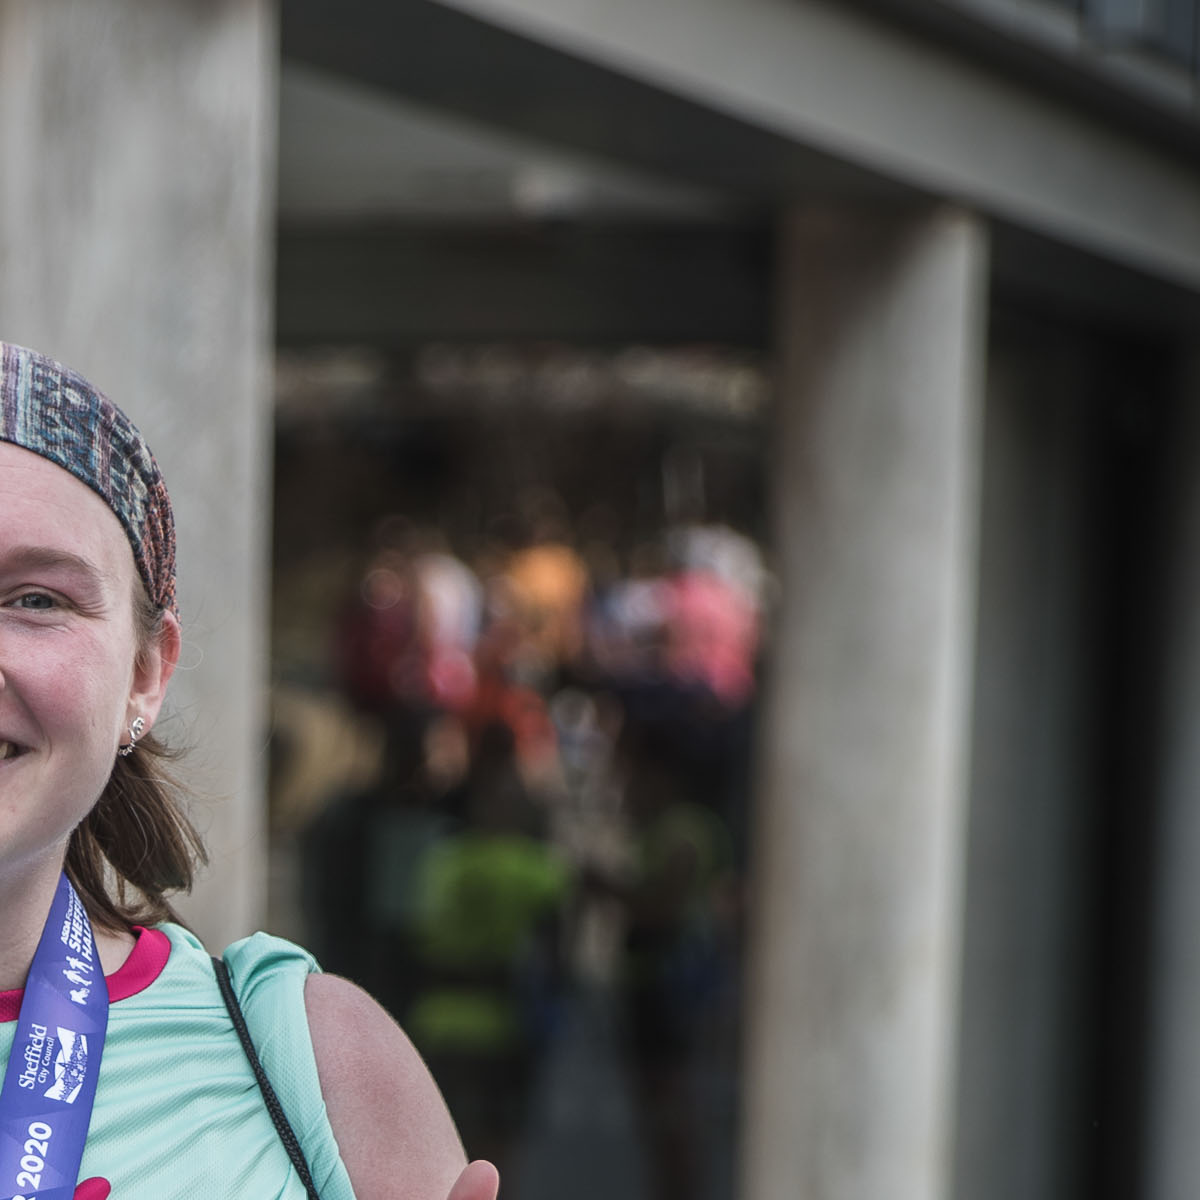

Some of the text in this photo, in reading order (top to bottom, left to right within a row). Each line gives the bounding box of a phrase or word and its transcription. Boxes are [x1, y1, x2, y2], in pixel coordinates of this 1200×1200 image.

[61, 920, 72, 945] ASDA
[81, 918, 93, 962] HALF
[18, 1023, 47, 1090] Sheffield
[37, 1036, 54, 1084] City Council
[16, 1121, 52, 1190] 2020
